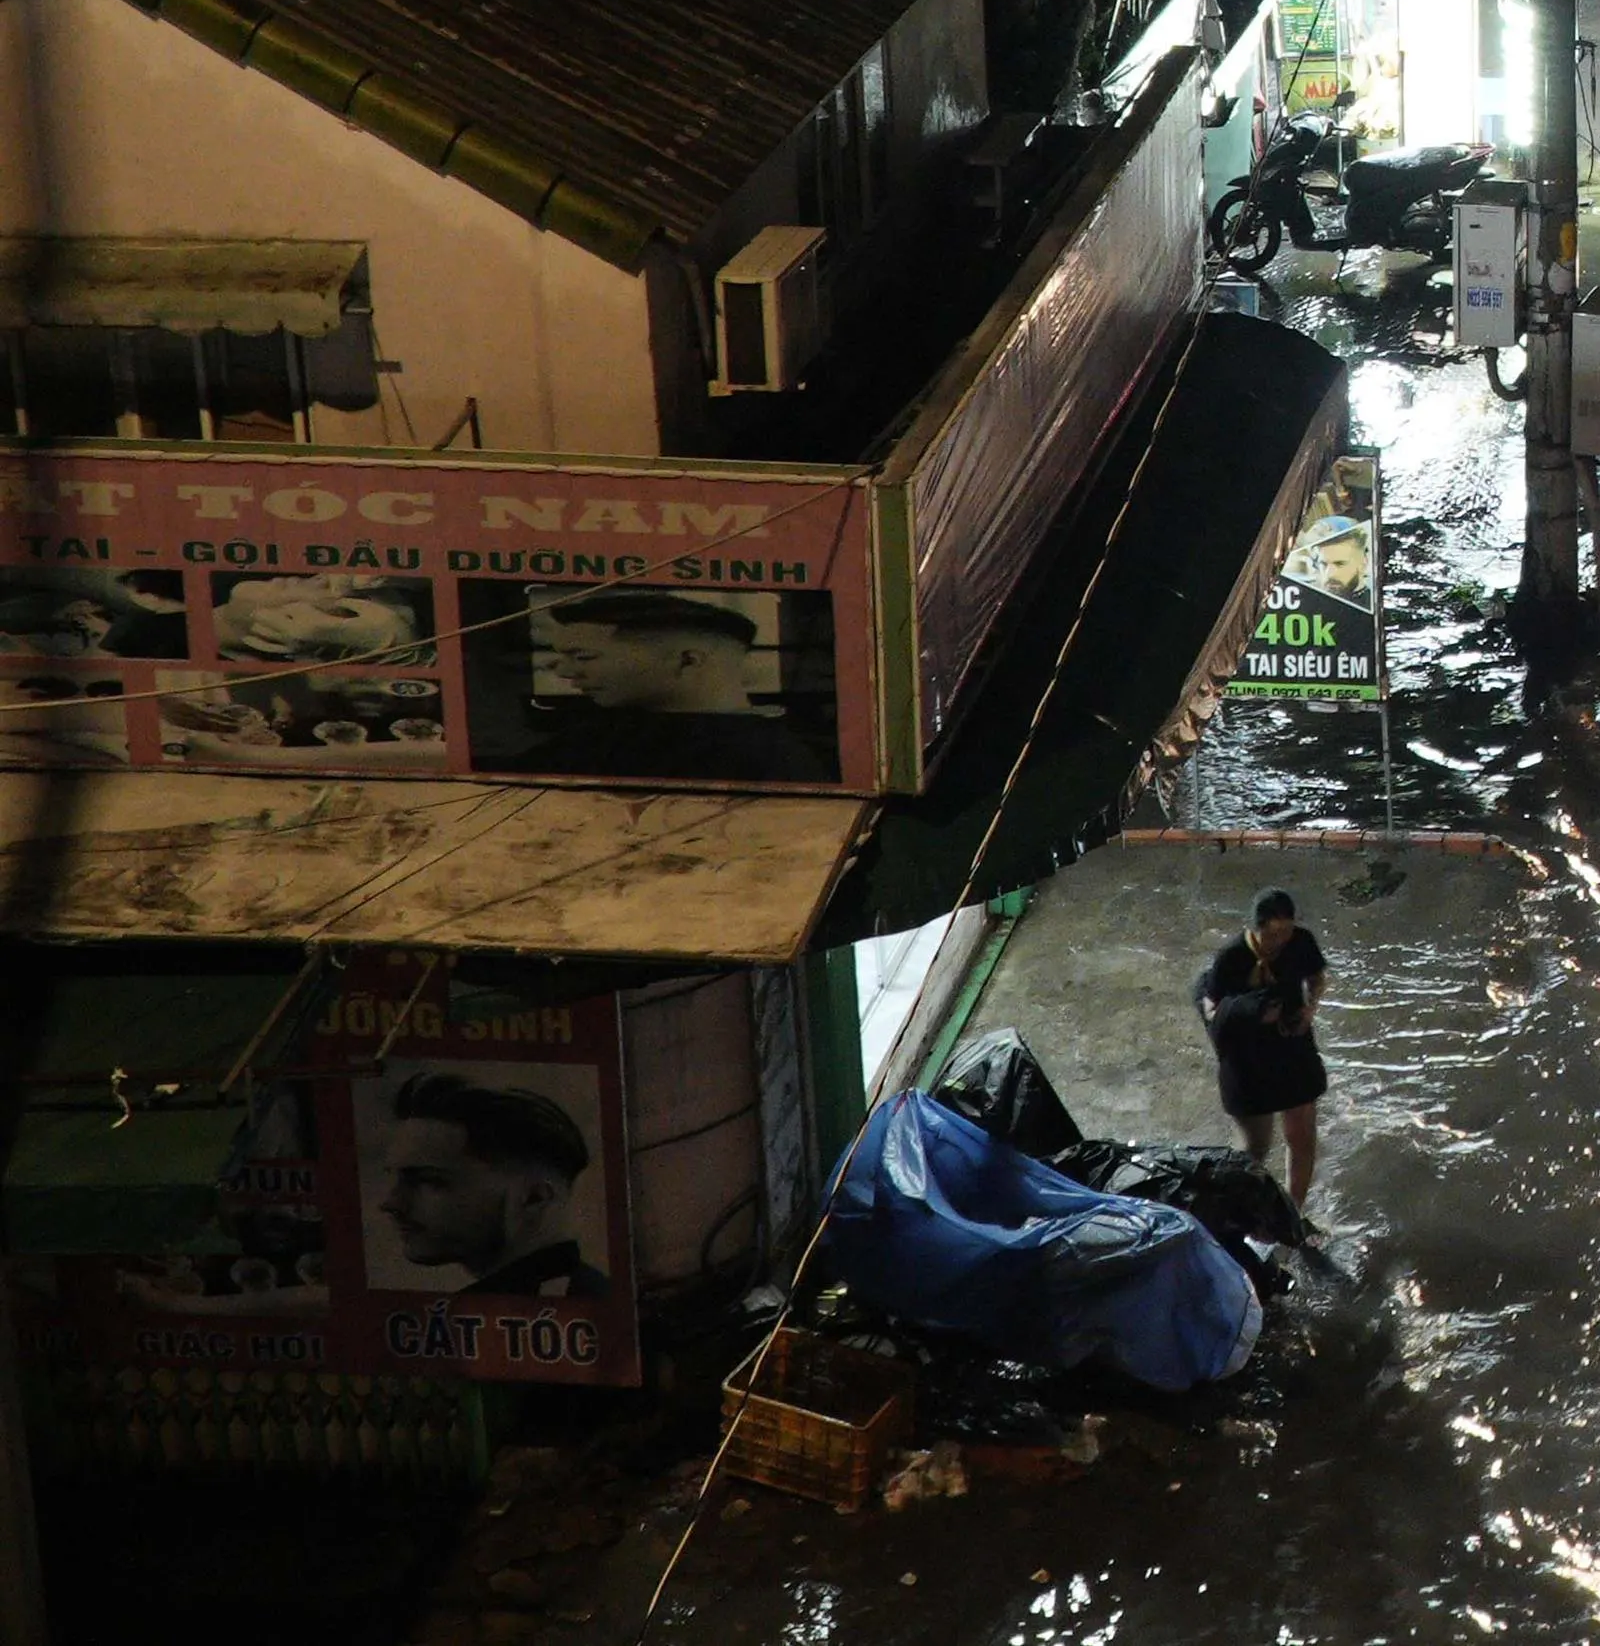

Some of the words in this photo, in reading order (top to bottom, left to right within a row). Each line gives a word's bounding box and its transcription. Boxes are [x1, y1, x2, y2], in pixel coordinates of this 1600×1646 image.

[177, 479, 435, 526] TÓC
[480, 496, 770, 538] NAM
[19, 535, 110, 560] TAI
[183, 537, 279, 569] GỘI
[447, 548, 647, 577] DƯỠNG
[672, 557, 807, 584] SINH
[1254, 613, 1336, 647] 40k
[1284, 650, 1331, 678] SIÊU
[1337, 651, 1368, 679] ÊM
[386, 1298, 486, 1360] CẮT
[496, 1308, 599, 1365] TÓC
